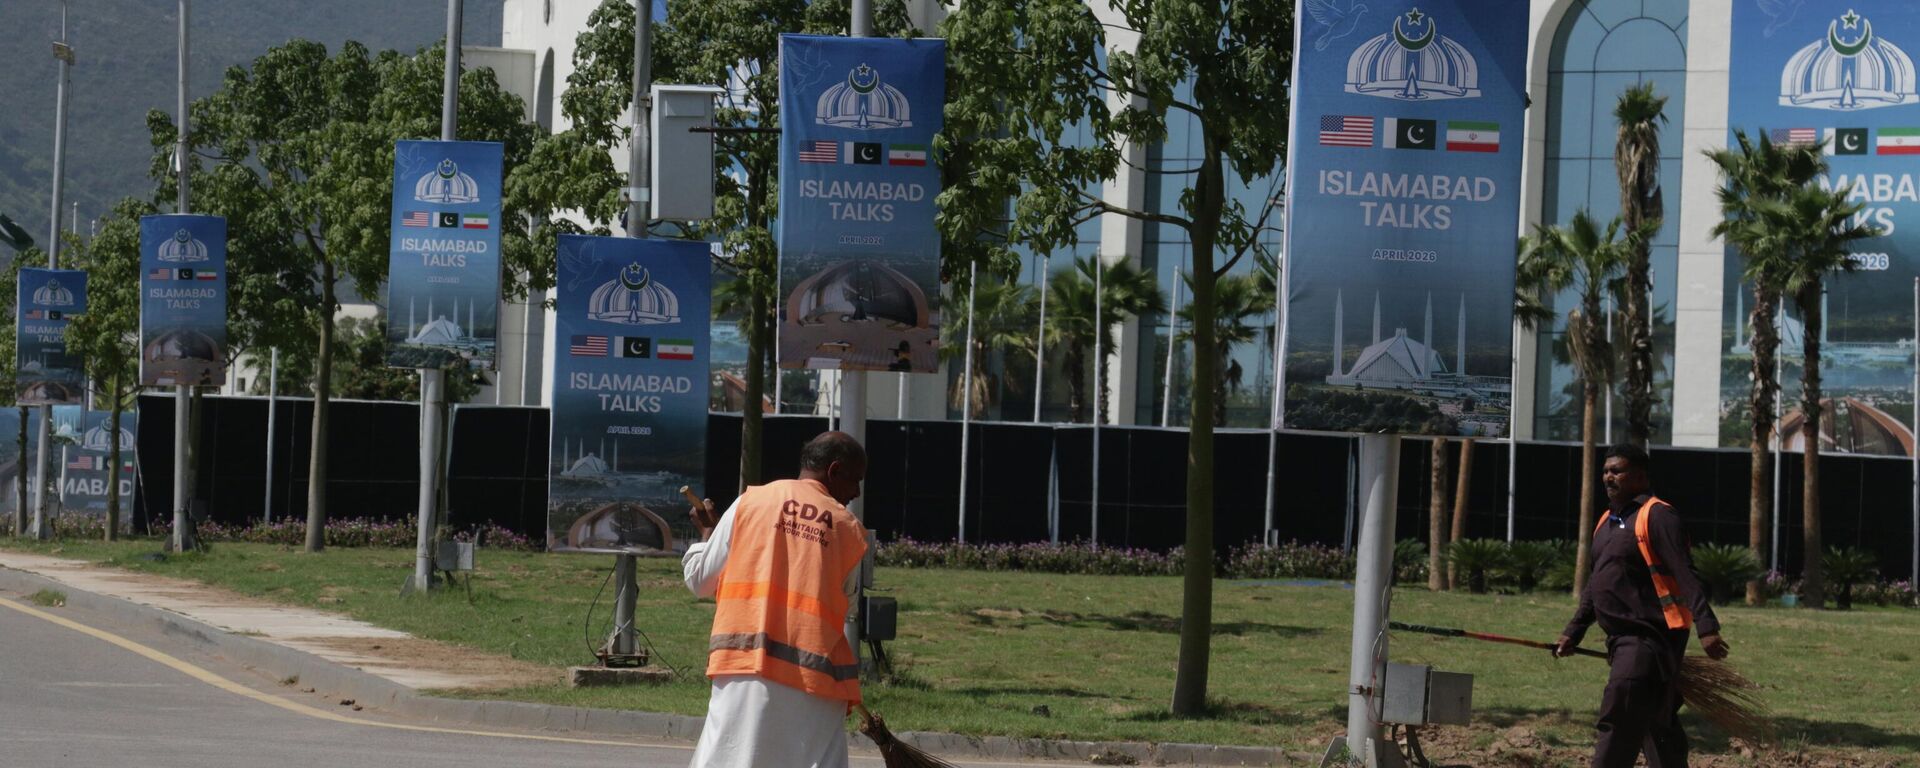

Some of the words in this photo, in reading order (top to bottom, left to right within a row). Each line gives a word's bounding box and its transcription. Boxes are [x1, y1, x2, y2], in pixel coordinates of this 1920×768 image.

[799, 179, 925, 202] ISLAMABAD
[1319, 169, 1496, 202] ISLAMABAD
[829, 202, 894, 222] TALKS
[1359, 201, 1452, 230] TALKS
[401, 238, 487, 253] ISLAMABAD
[421, 253, 466, 267] TALKS
[1372, 248, 1406, 261] APRIL
[1407, 249, 1437, 262] 2026
[150, 288, 216, 298] ISLAMABAD
[167, 299, 200, 309] TALKS
[25, 325, 65, 334] ISLAMAB
[570, 372, 692, 393] ISLAMABAD
[598, 393, 661, 413] TALKS
[607, 425, 630, 435] APRIL
[783, 499, 833, 529] CDA
[783, 526, 801, 537] YOUR
